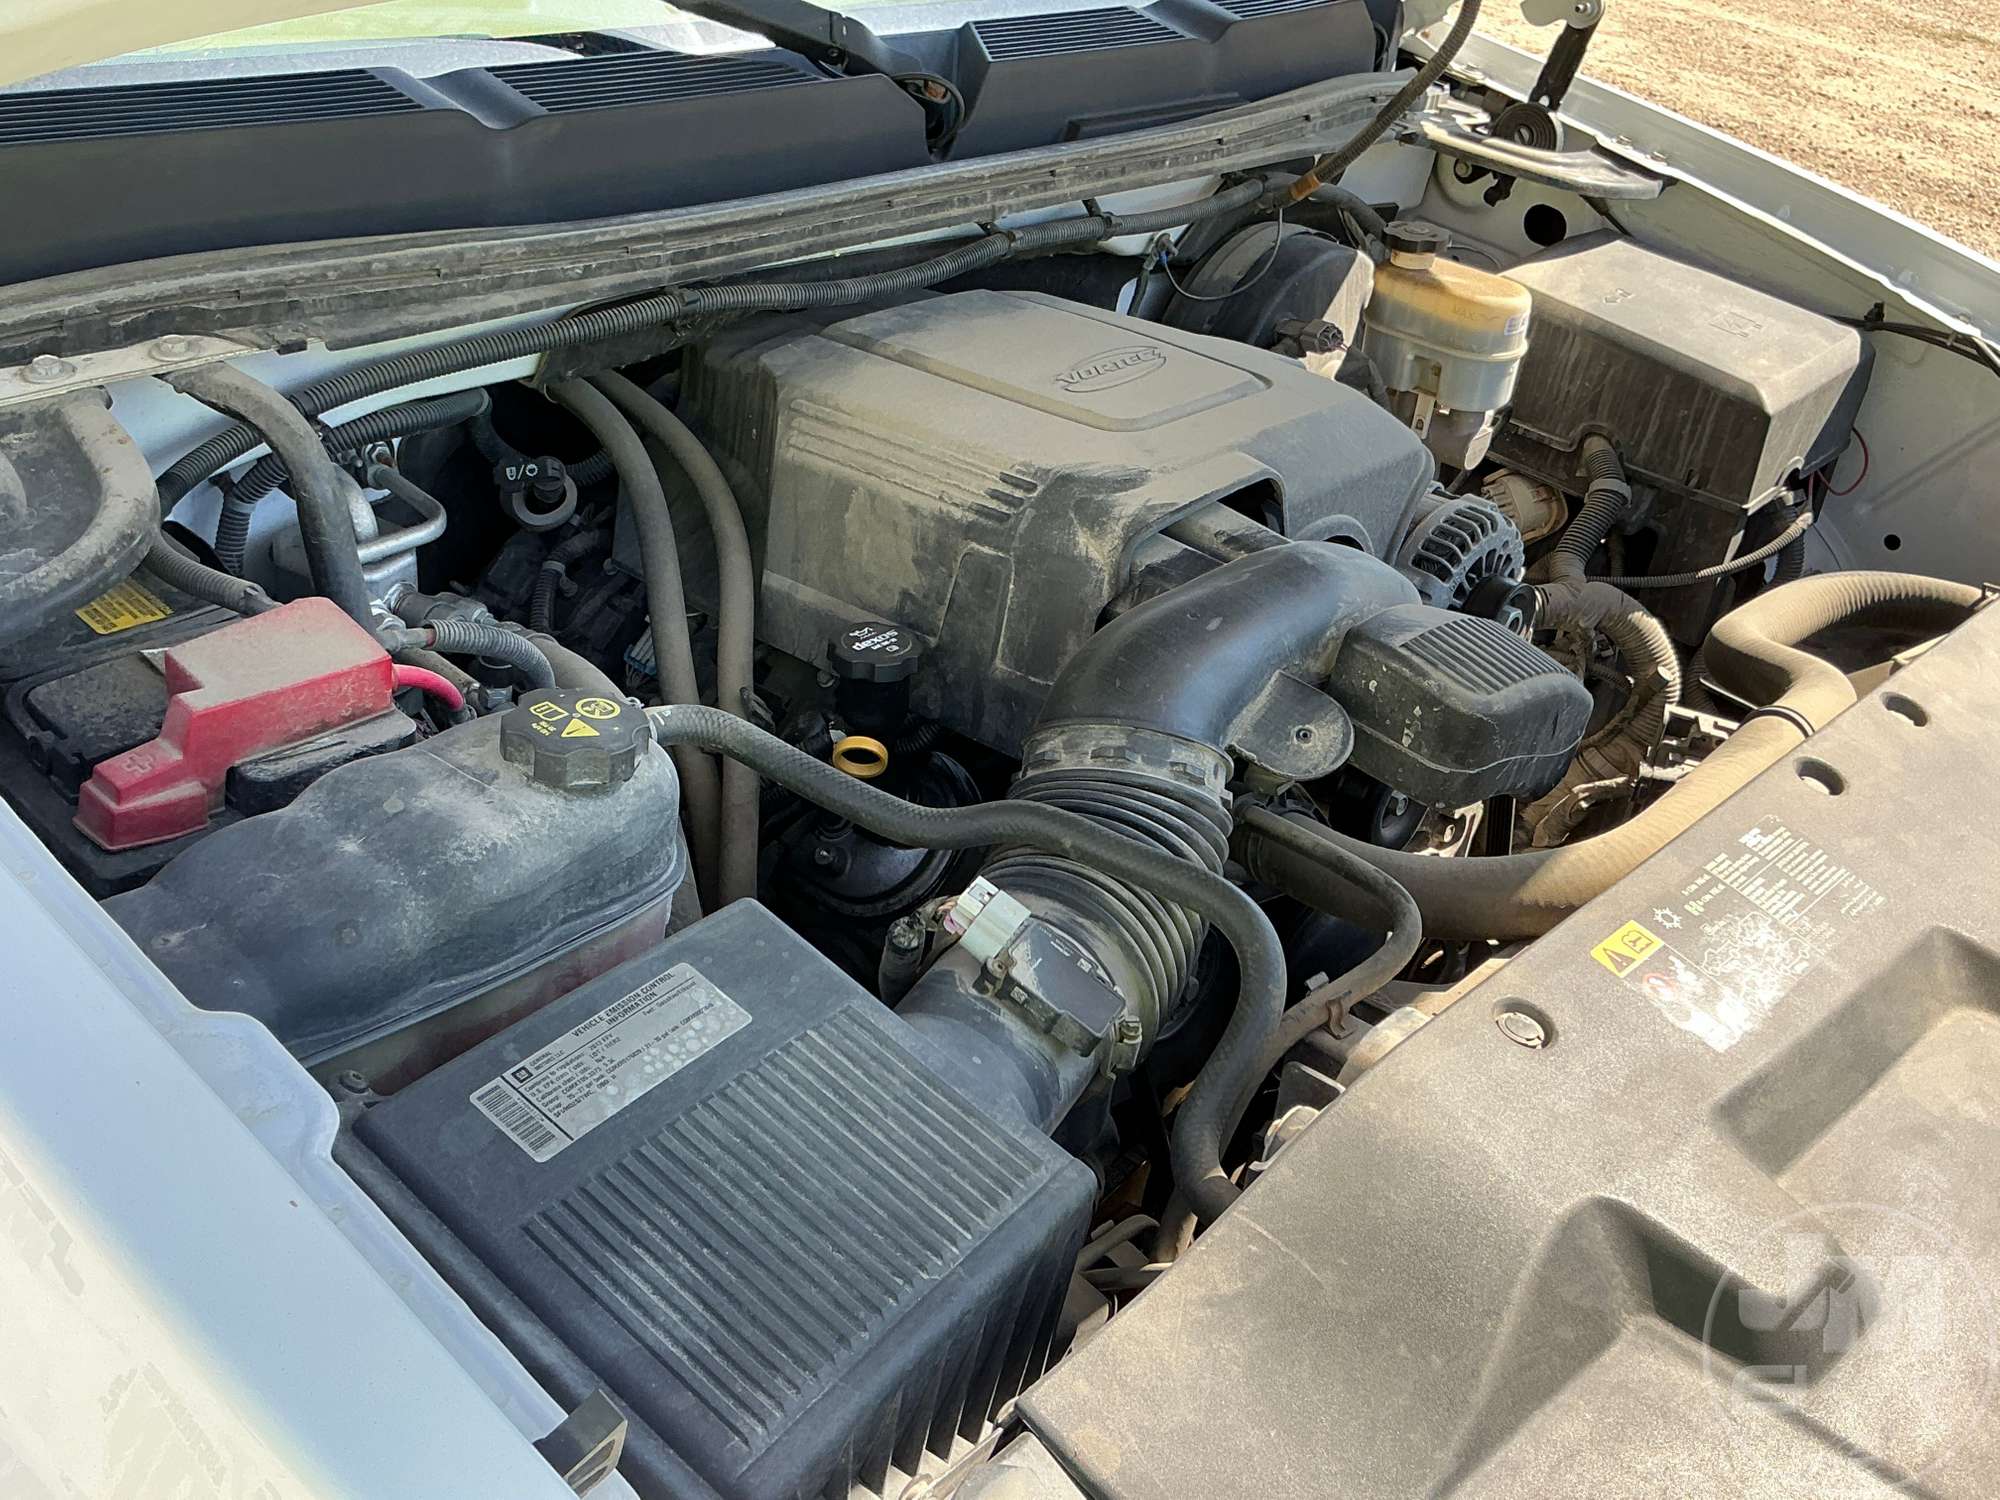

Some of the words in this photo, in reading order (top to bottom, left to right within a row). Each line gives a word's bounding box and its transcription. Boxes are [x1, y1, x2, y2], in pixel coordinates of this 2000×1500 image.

[1055, 349, 1162, 384] VORTEC
[852, 628, 899, 651] dexos
[571, 1015, 605, 1037] VEHICLE
[604, 992, 641, 1017] EMISSION
[640, 971, 675, 994] CONTROL
[605, 991, 658, 1026] INFORMATION
